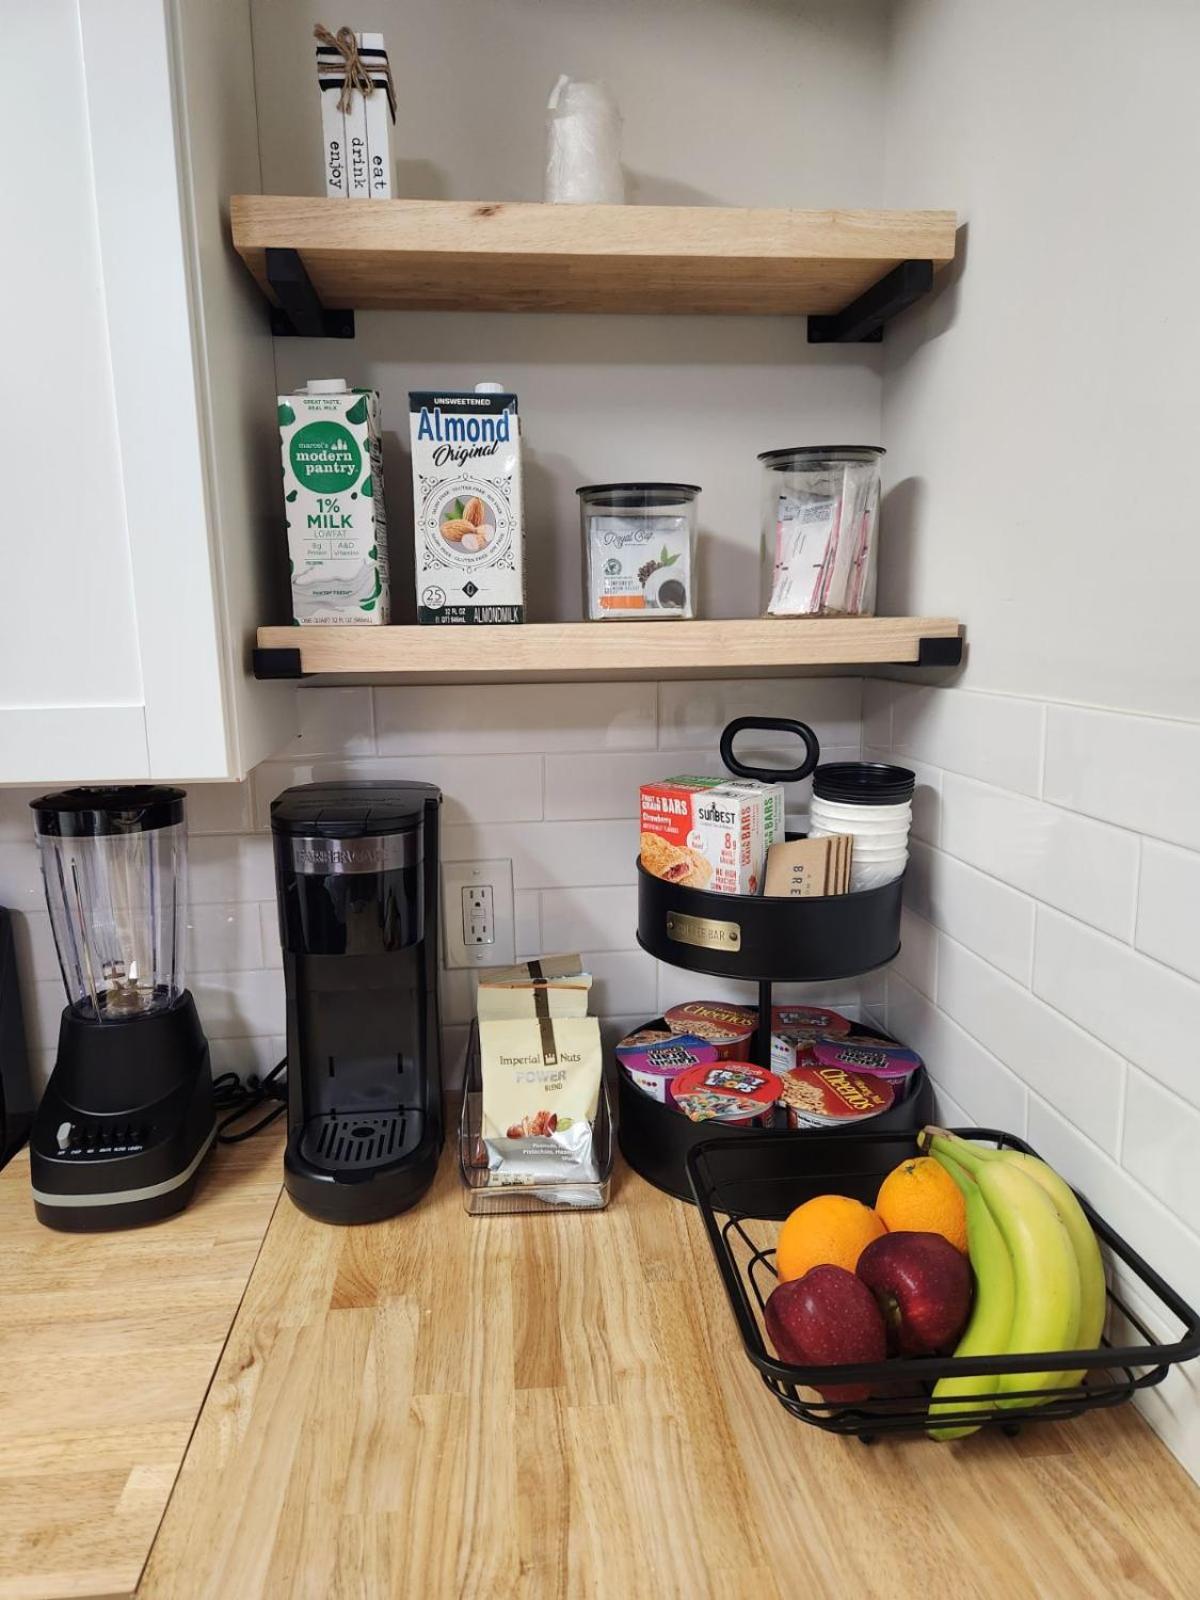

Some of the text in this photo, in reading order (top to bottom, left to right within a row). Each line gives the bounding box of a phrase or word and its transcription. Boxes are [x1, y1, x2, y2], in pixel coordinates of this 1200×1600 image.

[329, 141, 342, 190] enjoy
[351, 137, 367, 189] drink
[372, 155, 387, 190] eat
[433, 398, 491, 406] UNSWEETENED
[417, 406, 510, 443] Almond
[296, 450, 352, 461] modern
[432, 440, 499, 467] Original
[305, 462, 355, 476] pantry
[316, 498, 340, 513] 1%
[307, 514, 353, 529] MILK
[313, 530, 347, 538] LOWFAT
[603, 531, 633, 549] Royal
[426, 589, 442, 601] 25
[473, 607, 520, 623] ALMONDMILK
[662, 797, 688, 816] BARS
[764, 797, 773, 830] BARS
[741, 806, 751, 840] BARS
[707, 930, 726, 942] BAR
[499, 1052, 582, 1066] Imperial Nuts
[514, 1070, 567, 1083] POWER
[544, 1082, 563, 1092] BLEND
